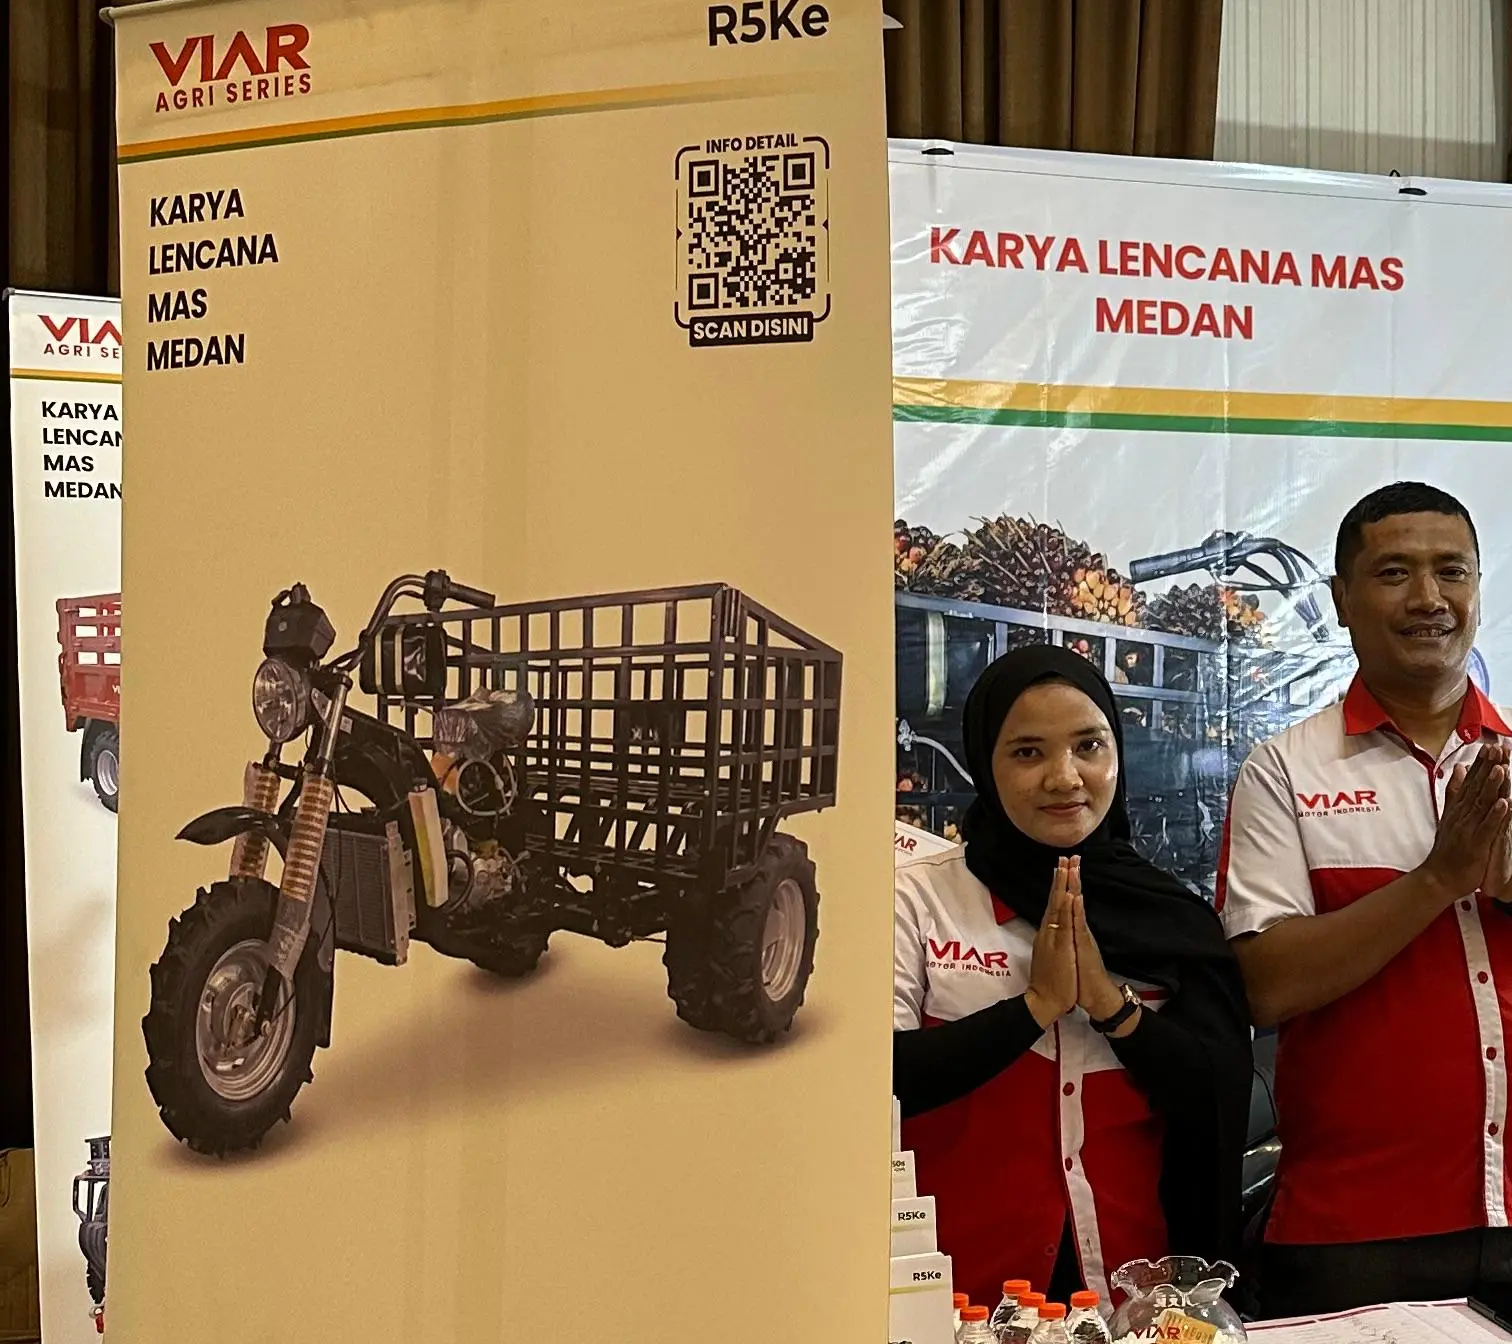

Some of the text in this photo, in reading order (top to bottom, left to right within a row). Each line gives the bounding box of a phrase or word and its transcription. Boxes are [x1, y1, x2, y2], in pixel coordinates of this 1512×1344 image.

[149, 23, 311, 86] VIAR
[155, 73, 312, 113] AGRI SERIES
[706, 133, 798, 153] INFO DETAIL
[150, 188, 244, 227] KARYA
[149, 233, 279, 274] LENCANA
[930, 226, 1404, 292] KARYA LENCANA MAS
[148, 288, 207, 323] MAS
[694, 318, 809, 340] SCAN DISINI
[1095, 297, 1254, 340] MEDAN
[44, 343, 90, 356] AGRI
[147, 333, 245, 371] MEDAN
[42, 401, 118, 420] KARYA
[44, 454, 94, 472] MAS
[44, 481, 122, 499] MEDAN
[1296, 790, 1378, 809] VIAR
[1334, 806, 1382, 815] INDONESIA
[928, 938, 1009, 968] VIAR
[898, 1210, 926, 1221] R5Ke
[913, 1271, 942, 1281] R5Ke
[1130, 1324, 1181, 1340] VIAR
